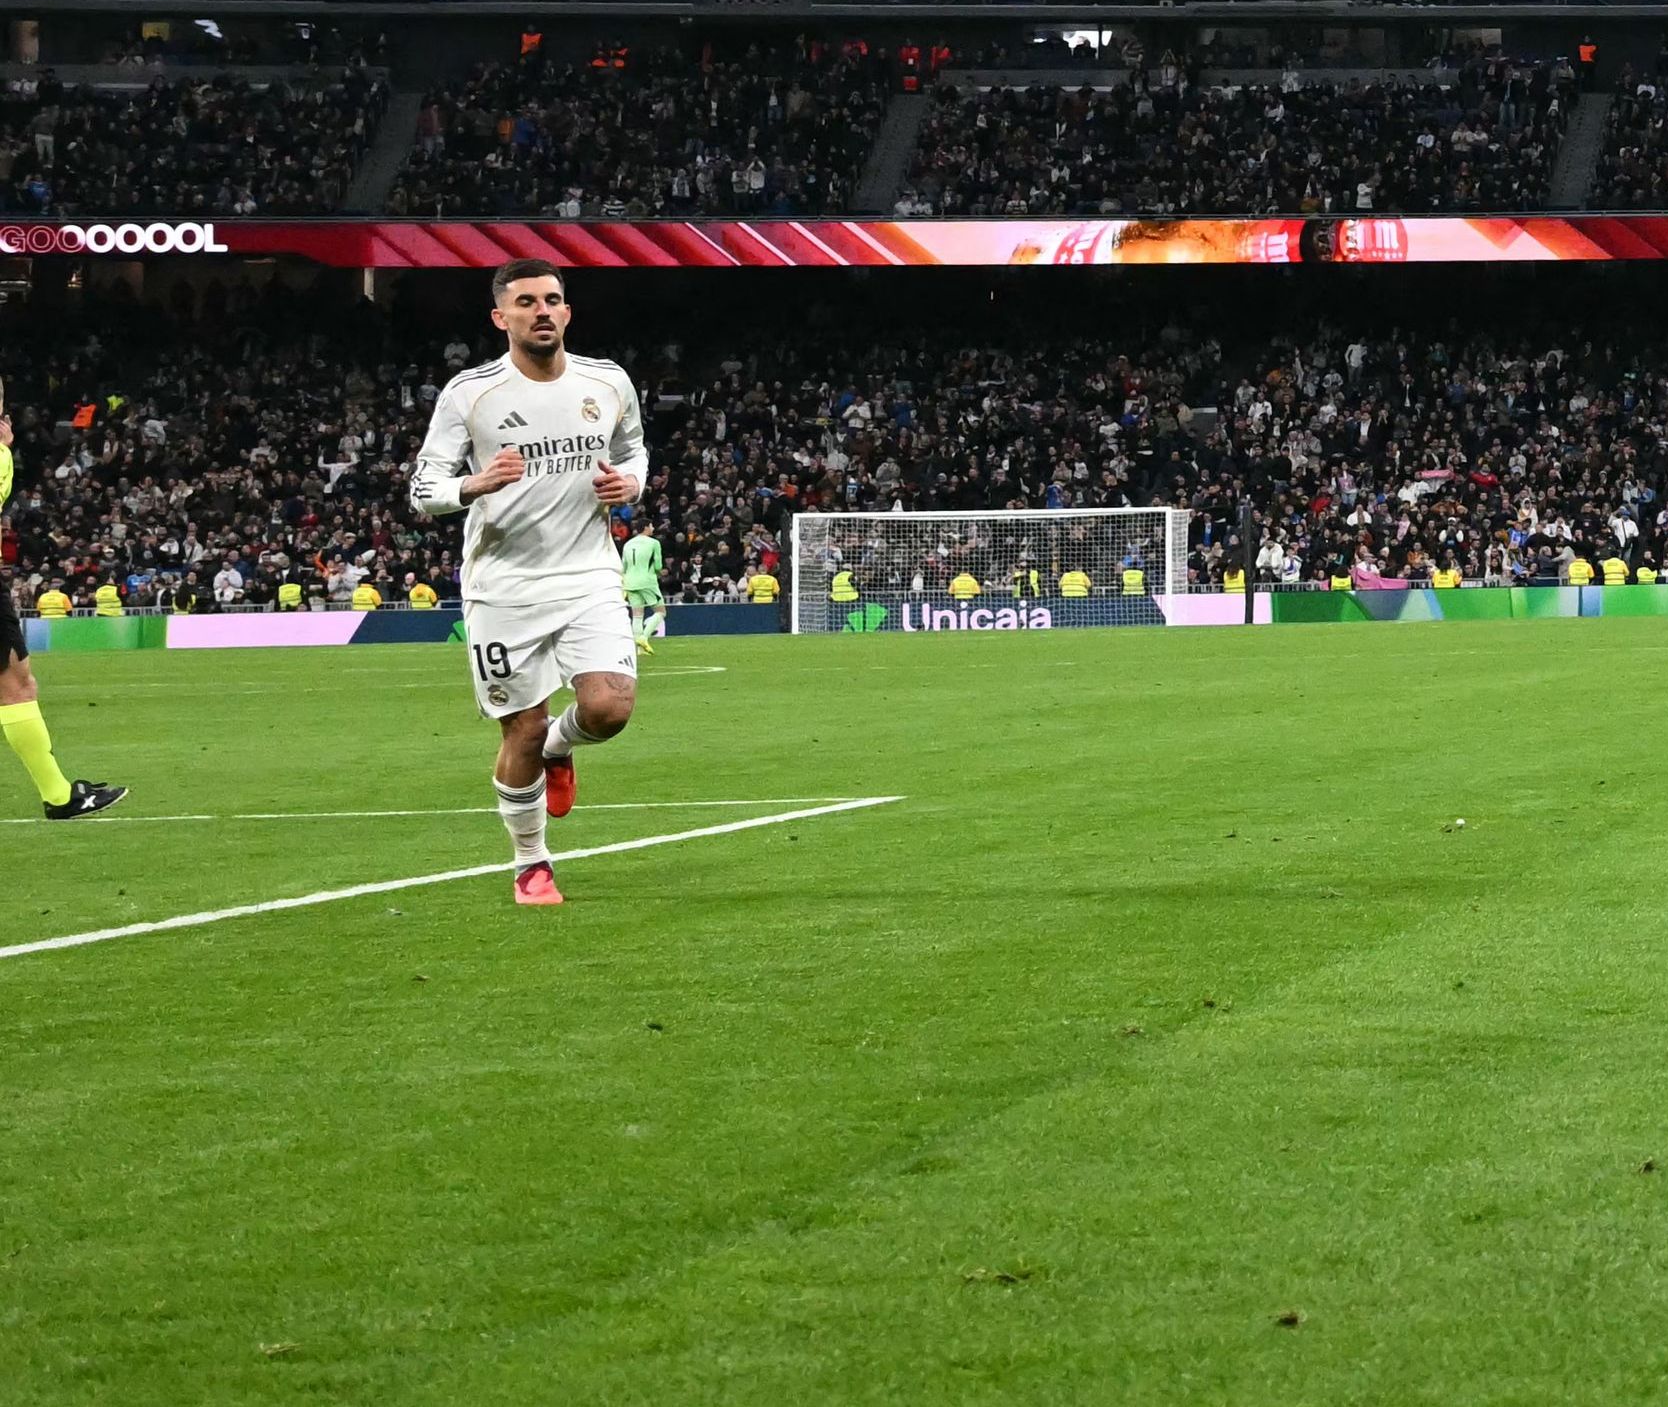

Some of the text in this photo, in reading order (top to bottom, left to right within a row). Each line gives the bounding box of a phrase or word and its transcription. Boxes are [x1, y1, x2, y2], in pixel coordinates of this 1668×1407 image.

[524, 455, 592, 477] LY BETTER
[472, 642, 512, 682] 19
